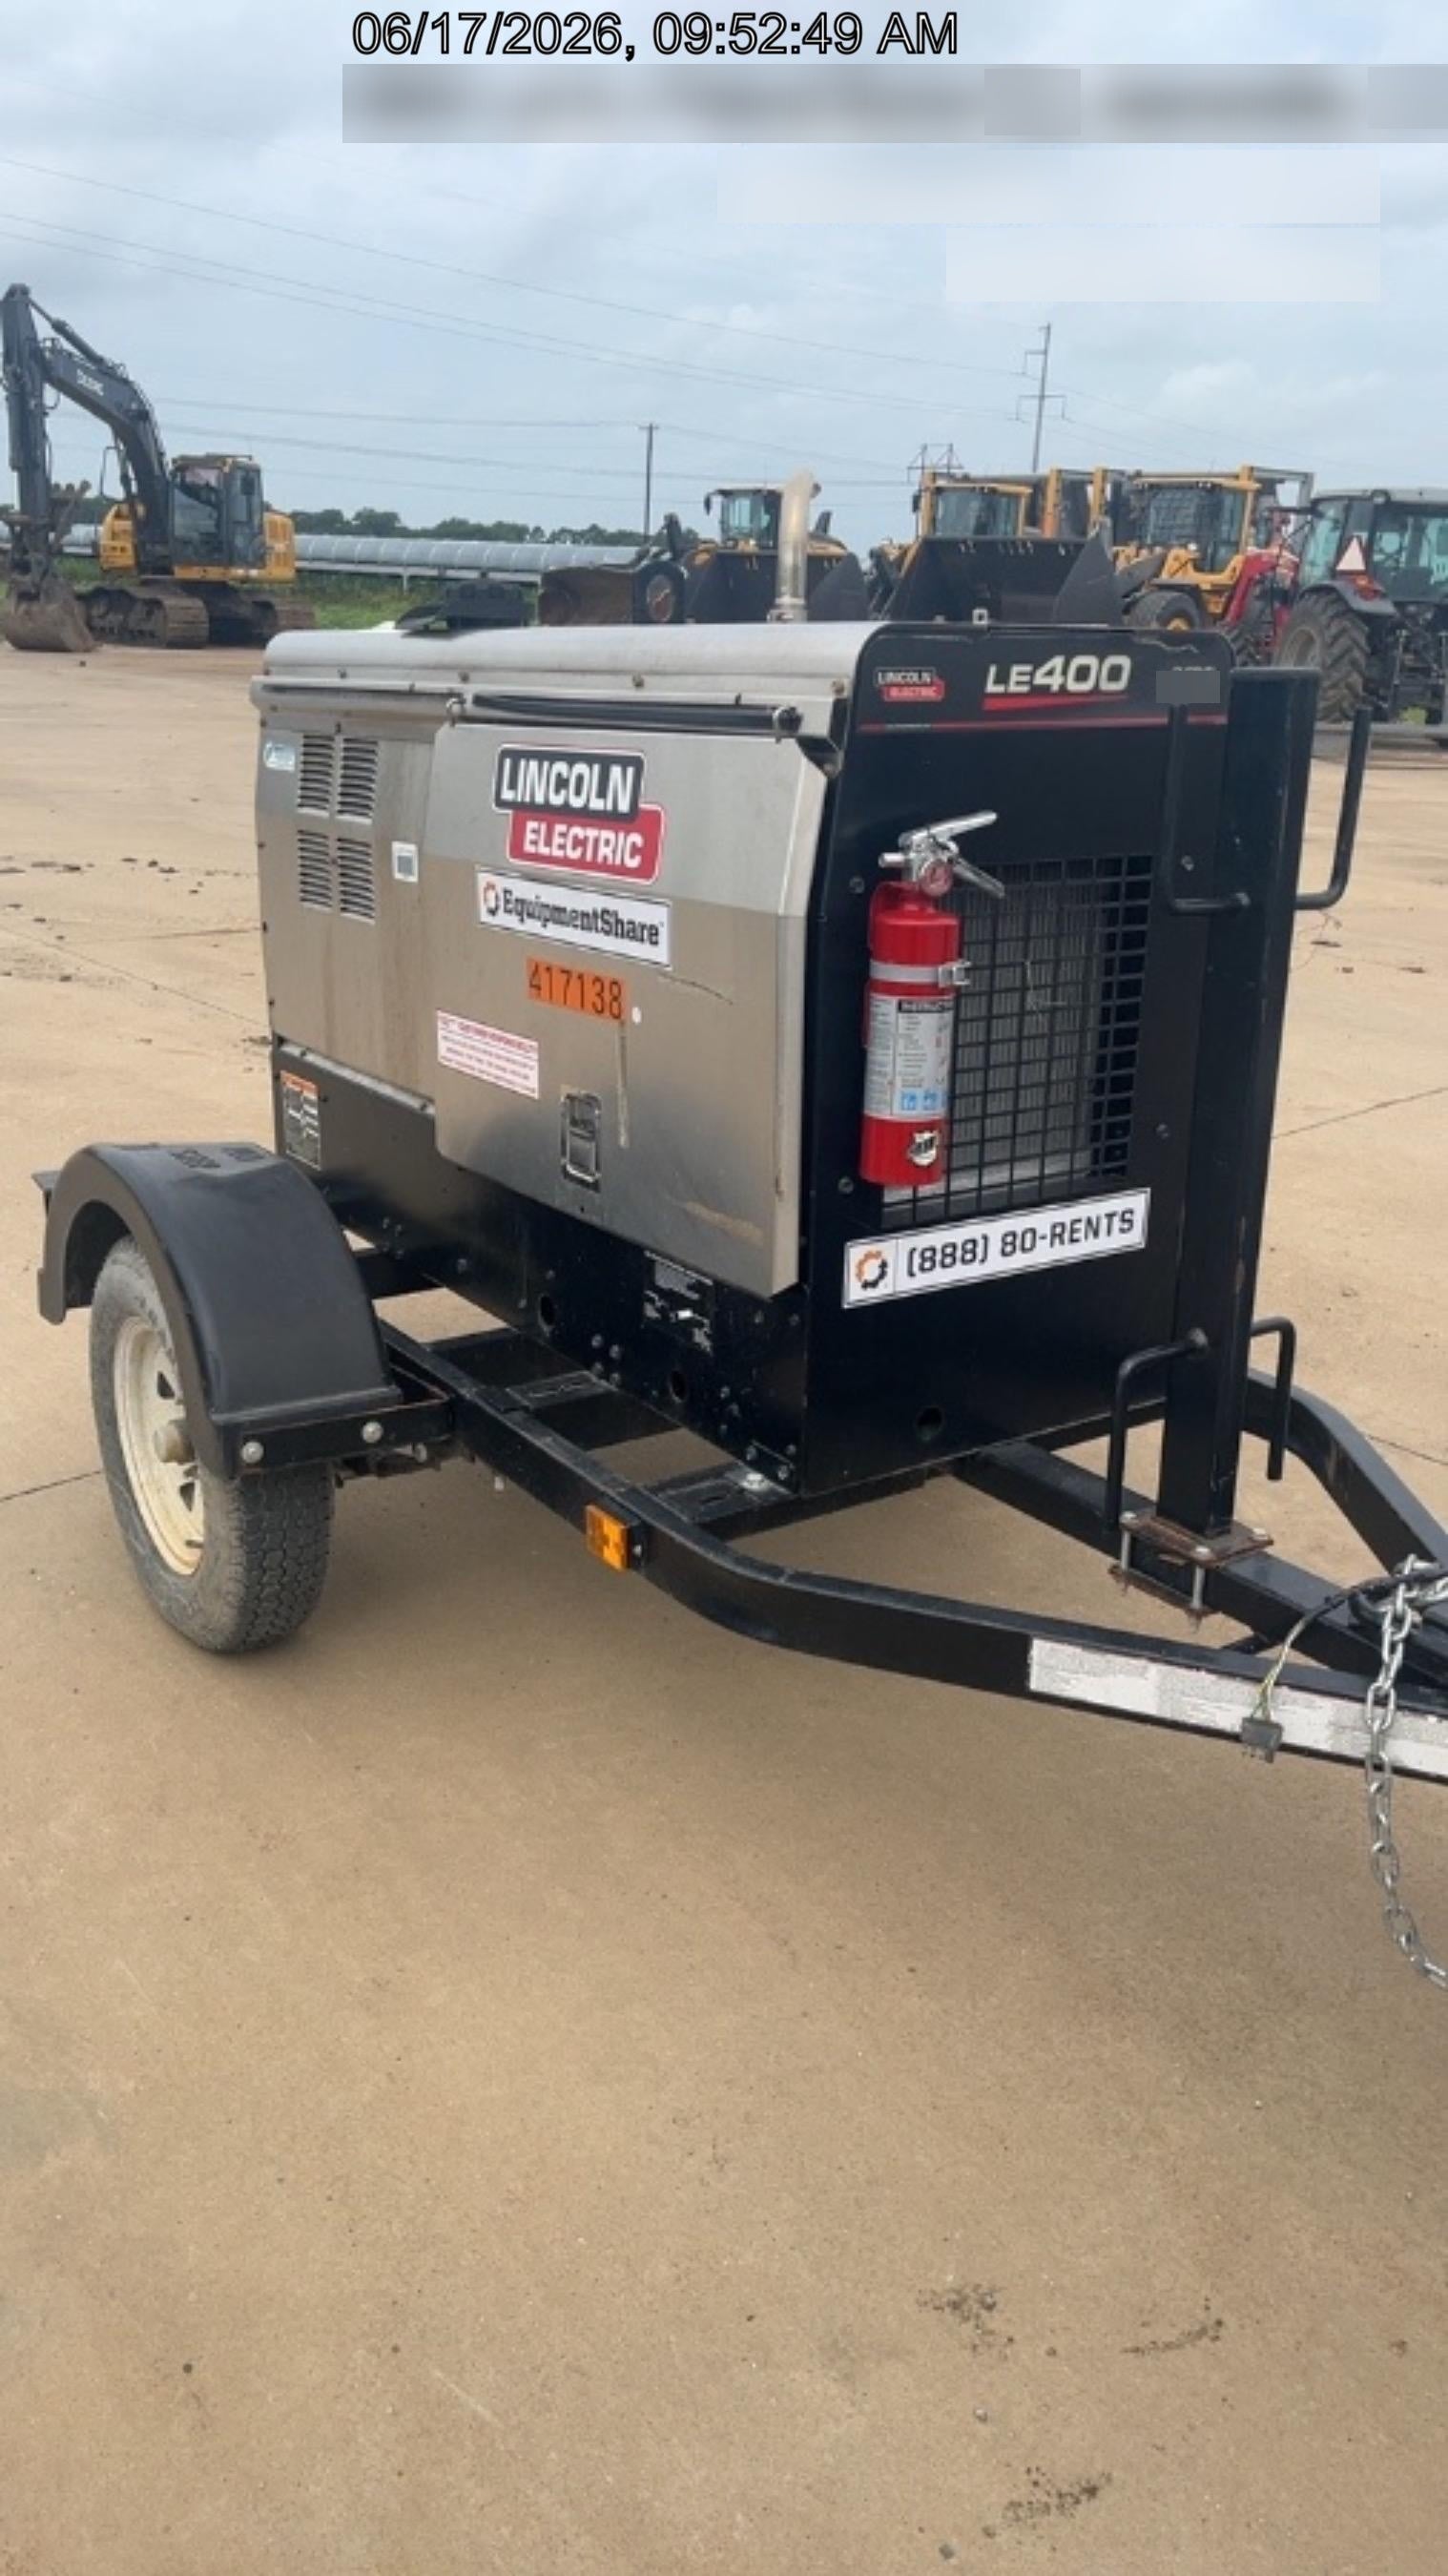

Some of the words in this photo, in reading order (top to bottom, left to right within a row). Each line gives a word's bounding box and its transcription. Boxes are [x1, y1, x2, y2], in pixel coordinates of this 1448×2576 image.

[877, 671, 933, 686] LINCOLN
[984, 654, 1132, 695] LE400
[499, 757, 636, 815] LINCOLN
[523, 820, 645, 869] ELECTRIC
[502, 888, 660, 946] EquipmentShare
[528, 961, 623, 1021] 417138
[907, 1233, 989, 1278] (888)
[1001, 1207, 1135, 1257] 80-RENTS
